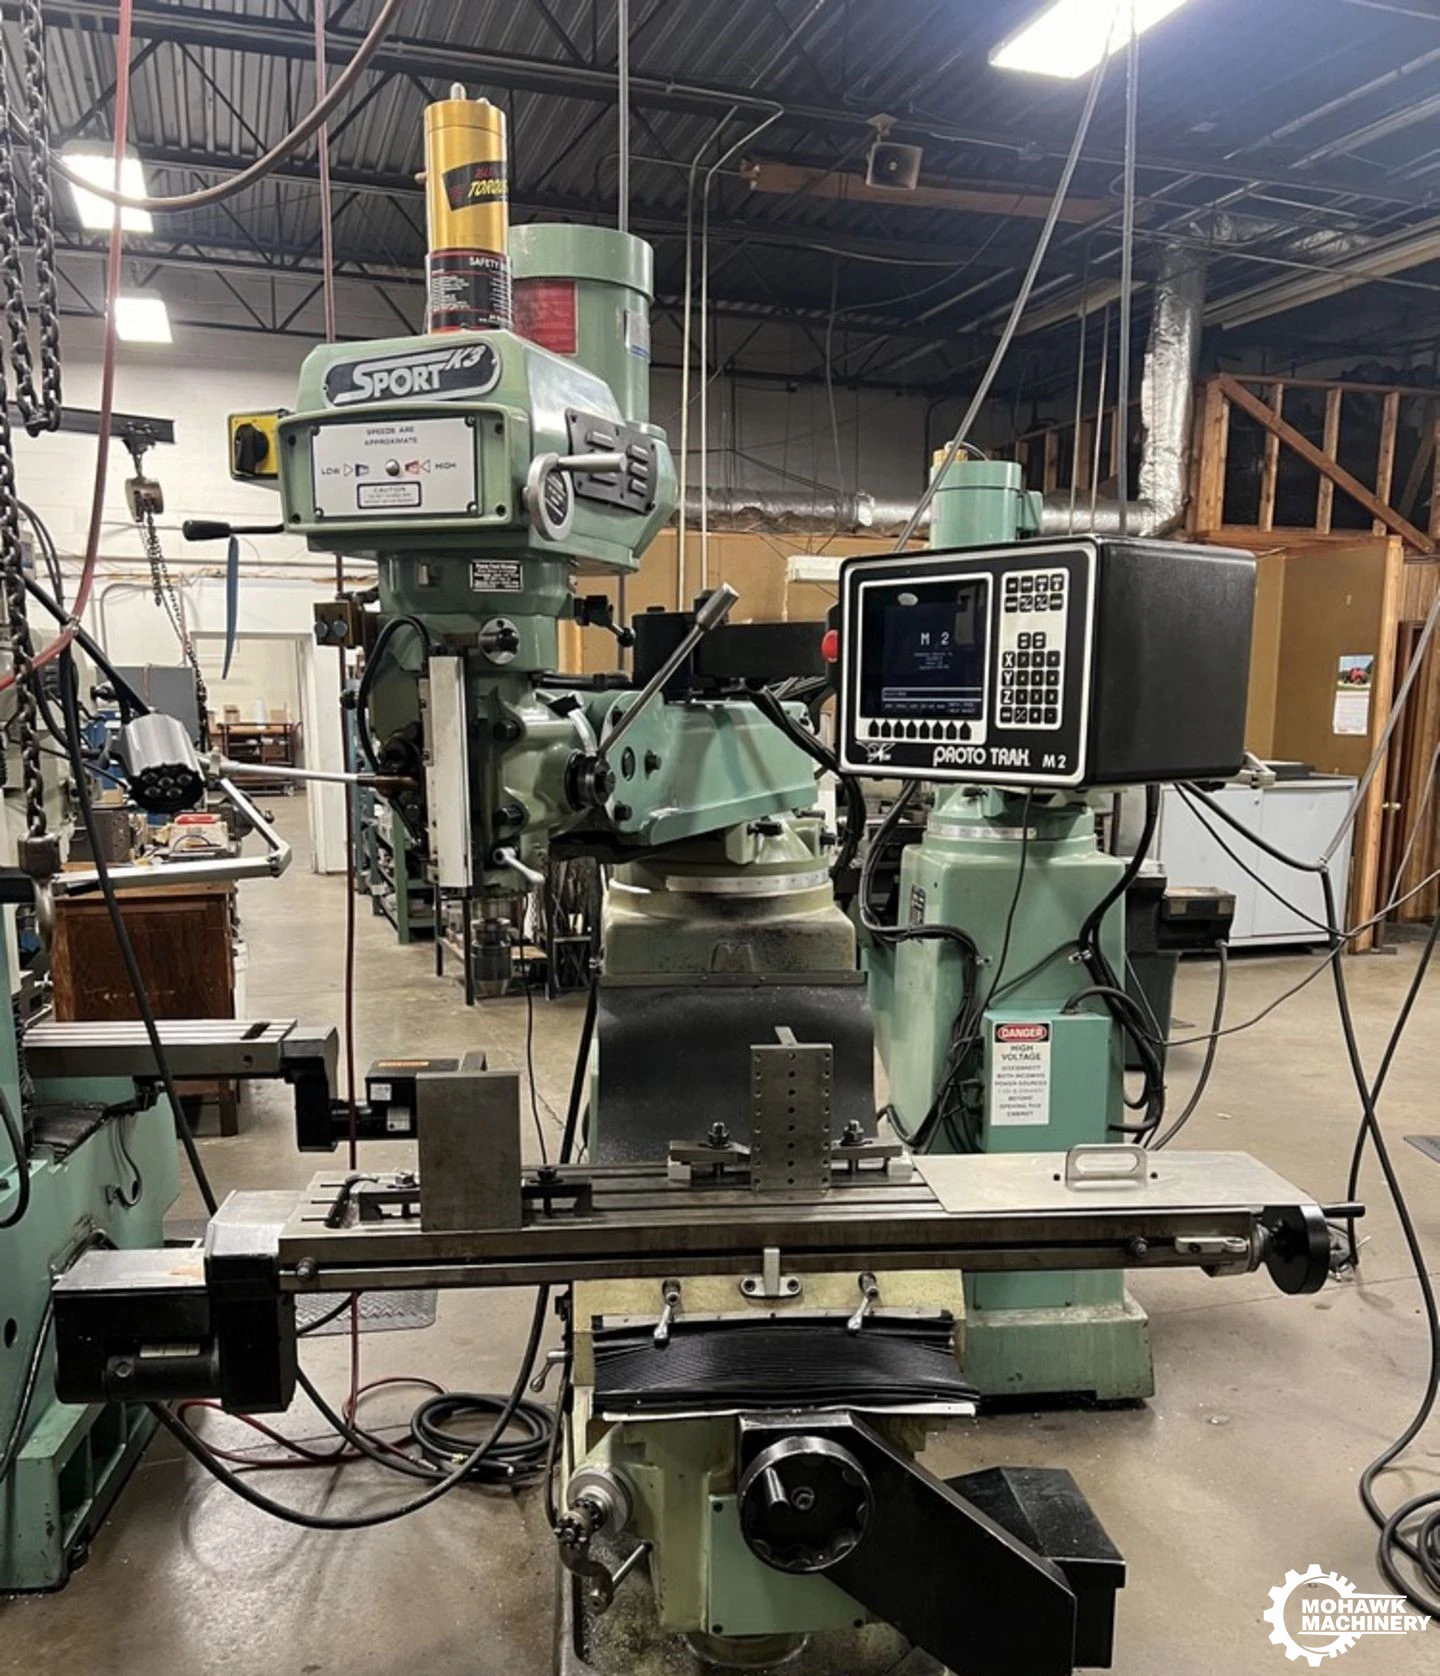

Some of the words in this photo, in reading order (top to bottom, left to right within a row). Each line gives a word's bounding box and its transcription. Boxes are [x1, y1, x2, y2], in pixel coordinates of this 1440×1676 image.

[469, 256, 499, 272] SAFETY
[333, 354, 447, 404] SPORT
[443, 344, 487, 371] K3
[364, 436, 418, 447] APPROXIMATE
[321, 467, 341, 475] LOW
[435, 461, 457, 470] HIGH
[920, 632, 930, 645] M
[940, 631, 950, 645] 2
[1004, 653, 1013, 667] X
[1003, 671, 1013, 685] Y
[1002, 690, 1012, 703] Z
[932, 746, 986, 767] PROTO
[990, 747, 1030, 767] TRAK
[1001, 1027, 1043, 1038] DANGER
[1010, 1044, 1034, 1052] HIGH
[1001, 1053, 1042, 1061] VOLTAGE
